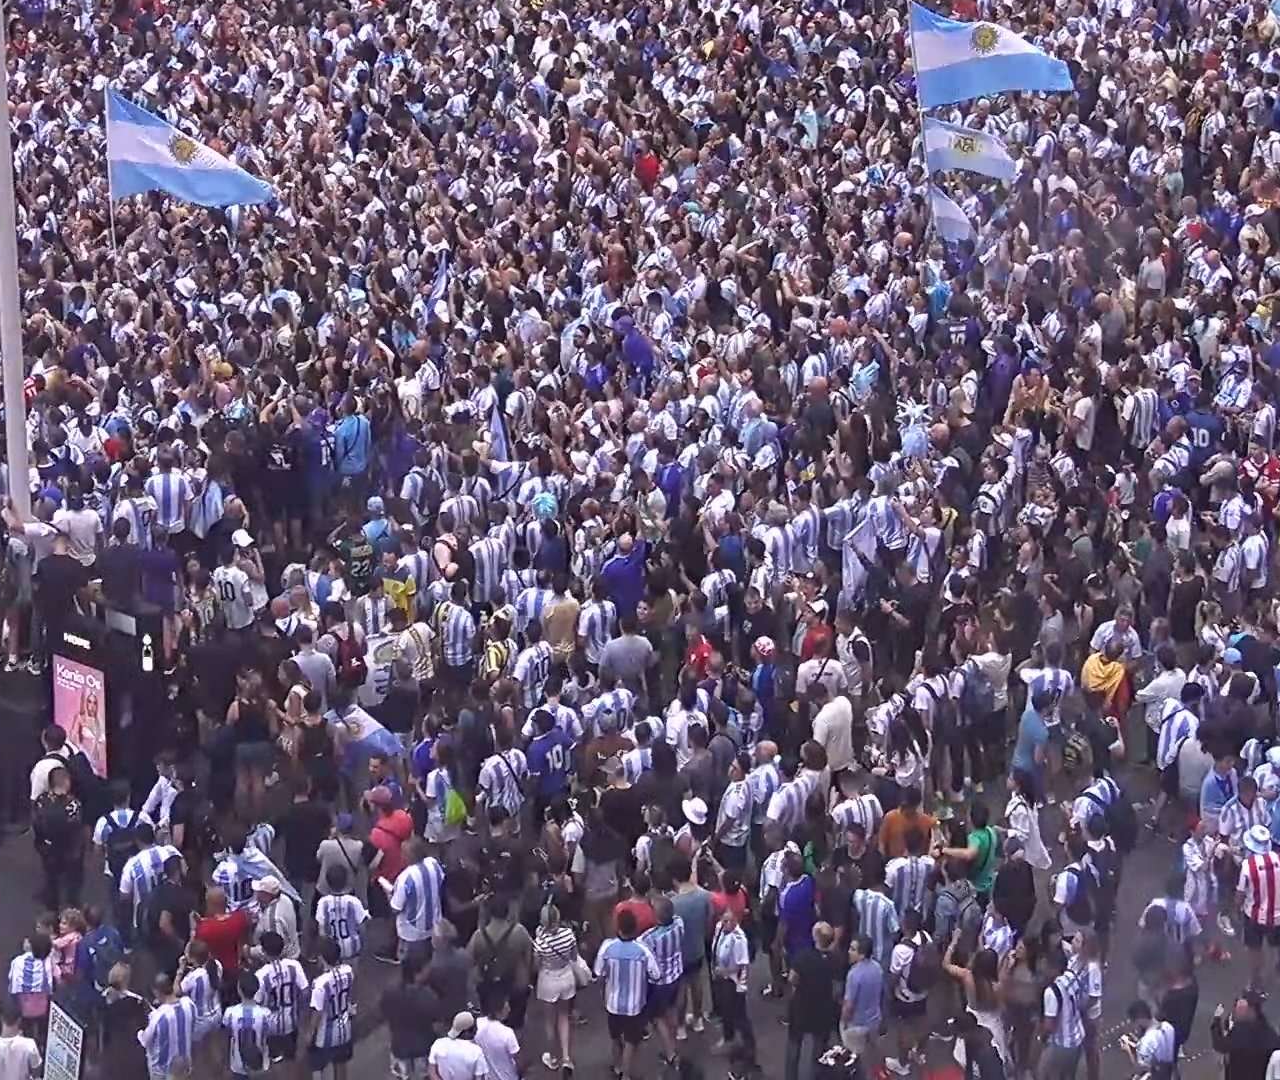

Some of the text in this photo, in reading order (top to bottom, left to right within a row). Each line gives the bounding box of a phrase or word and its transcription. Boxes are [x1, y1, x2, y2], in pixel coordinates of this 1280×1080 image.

[1191, 426, 1209, 447] 10
[351, 558, 371, 577] 22
[217, 579, 236, 602] 10
[546, 743, 563, 770] 10
[331, 918, 350, 939] 10
[273, 982, 294, 1007] 10
